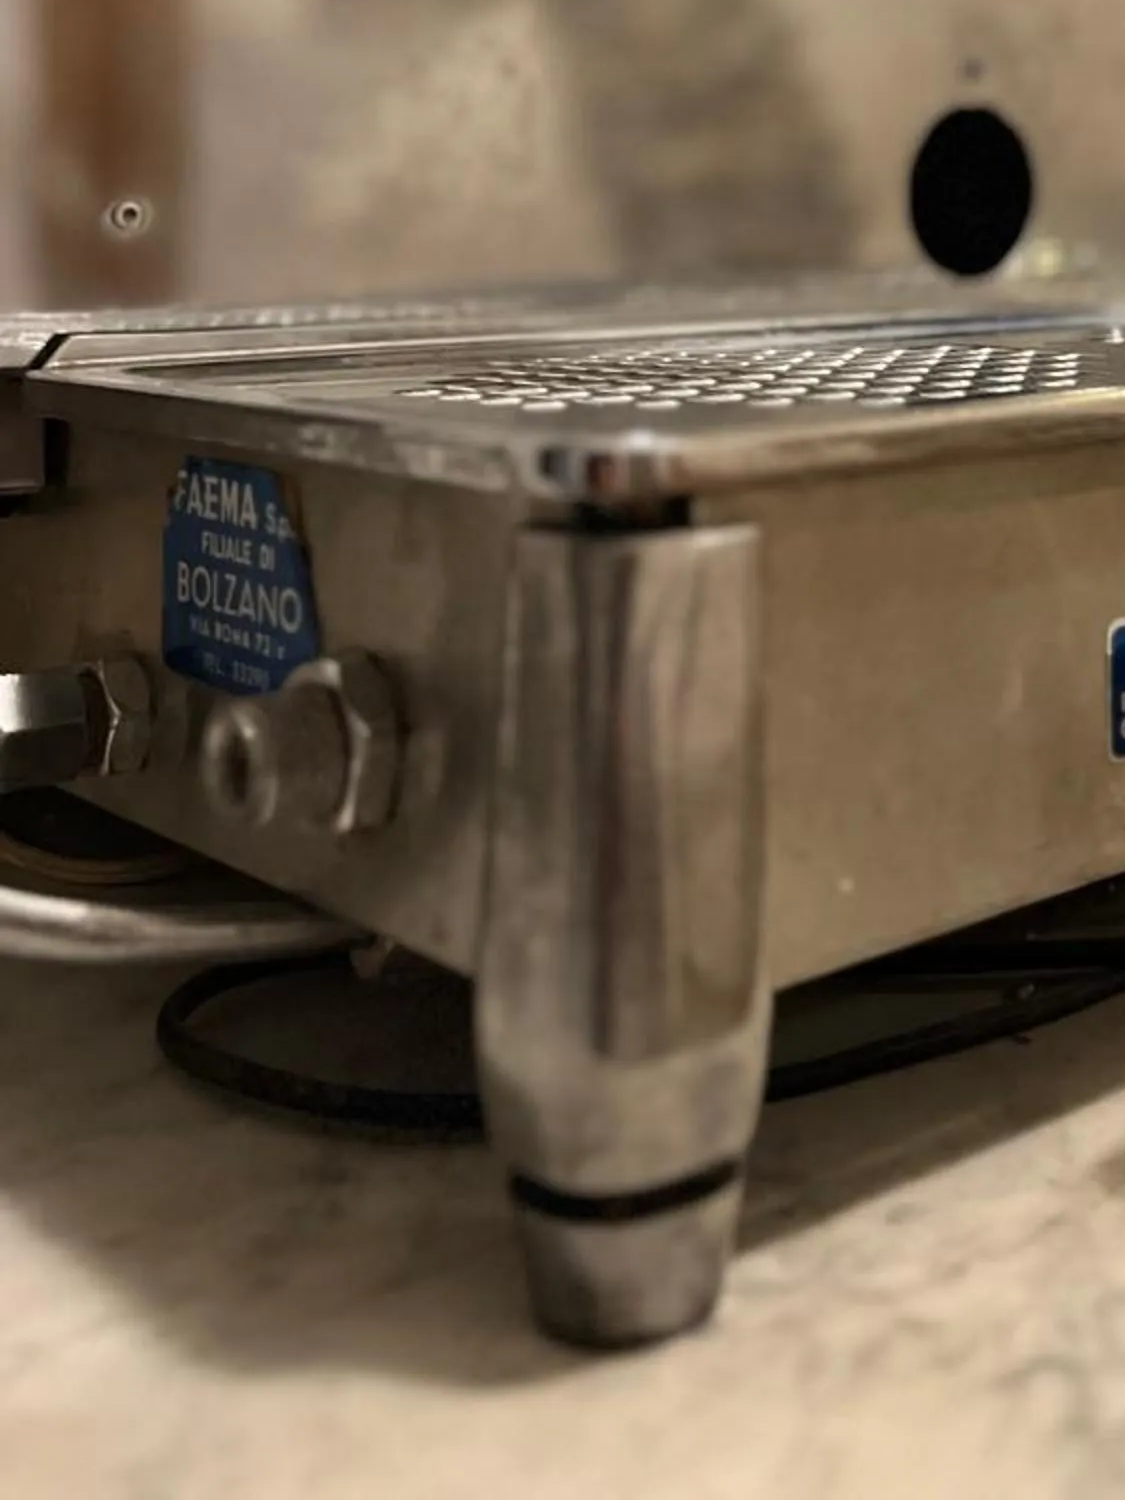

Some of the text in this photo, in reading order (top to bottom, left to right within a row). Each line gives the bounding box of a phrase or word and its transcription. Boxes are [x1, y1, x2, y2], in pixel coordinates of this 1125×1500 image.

[201, 531, 275, 571] FILIALE DI
[177, 560, 303, 633] BOLZANO
